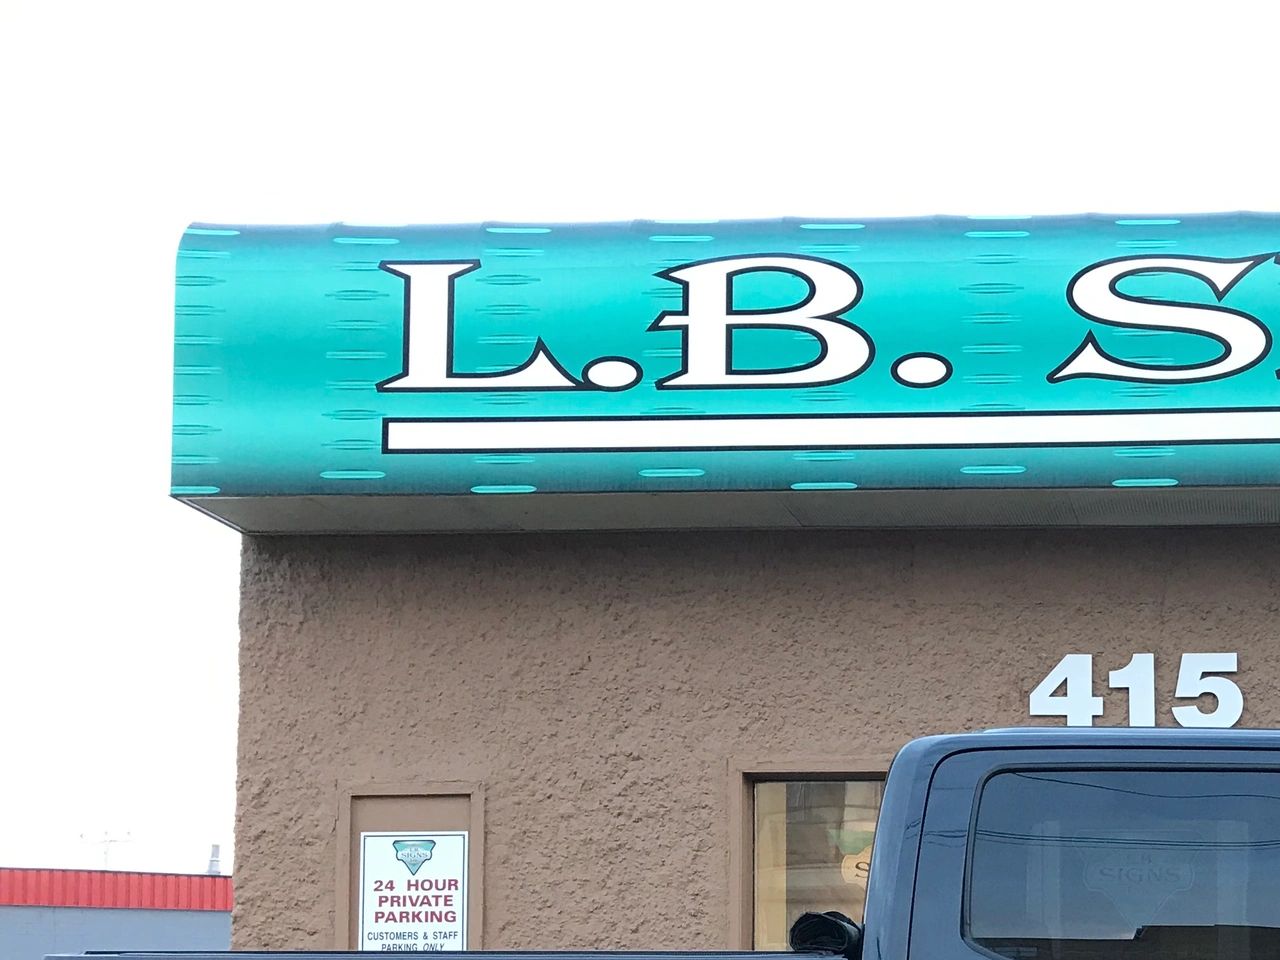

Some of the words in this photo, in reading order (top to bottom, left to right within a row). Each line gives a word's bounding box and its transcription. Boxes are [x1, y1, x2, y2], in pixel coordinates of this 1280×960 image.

[375, 252, 953, 392] L.B.
[1029, 652, 1244, 727] 415
[373, 880, 396, 892] 24
[407, 879, 459, 891] HOUR
[378, 895, 454, 907] PRIVATE
[374, 910, 457, 923] PARKING
[367, 931, 419, 941] CUSTOMERS
[422, 931, 429, 940] &
[432, 931, 459, 940] STAFF
[381, 943, 418, 952] PARKING
[422, 943, 445, 952] ONLY
